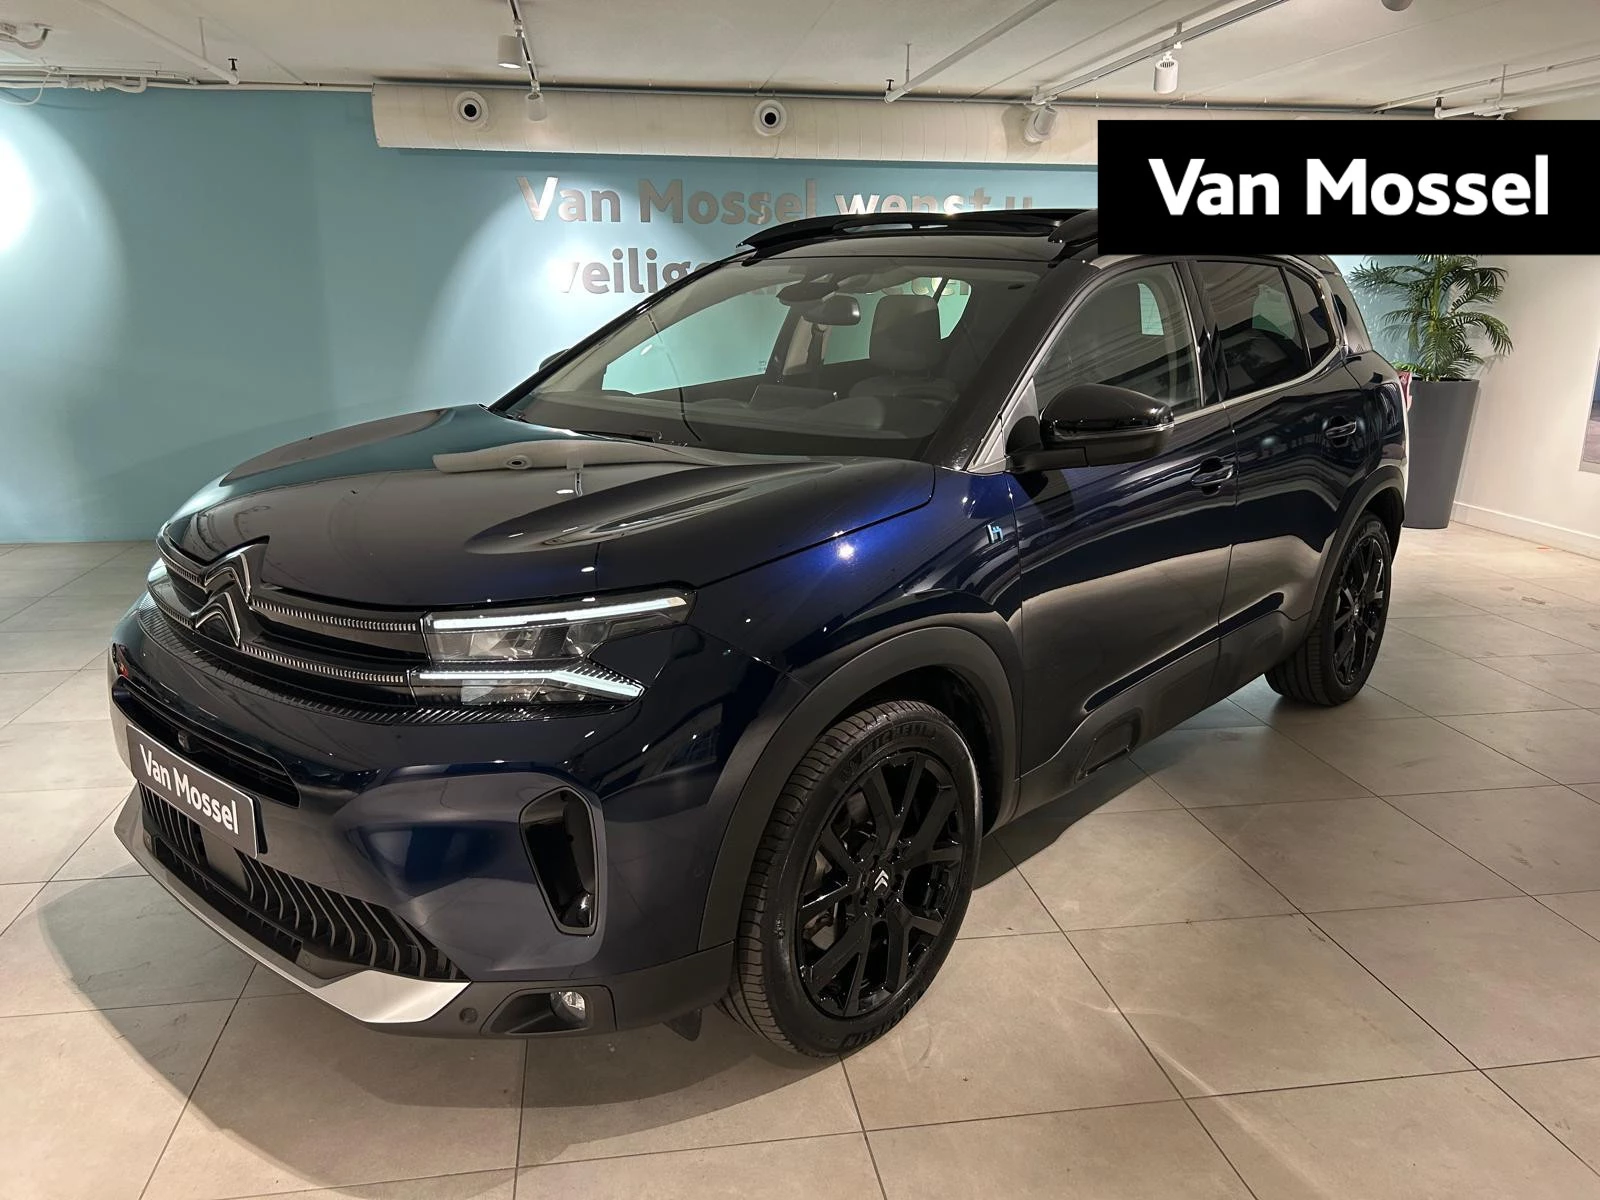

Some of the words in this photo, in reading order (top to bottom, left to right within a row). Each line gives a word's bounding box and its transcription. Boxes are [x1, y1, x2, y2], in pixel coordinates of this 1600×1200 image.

[516, 176, 622, 223] Van
[638, 178, 819, 224] Mossel
[834, 187, 992, 215] wenst
[554, 247, 711, 296] veilig
[139, 743, 173, 792] Van
[173, 766, 239, 835] Mossel
